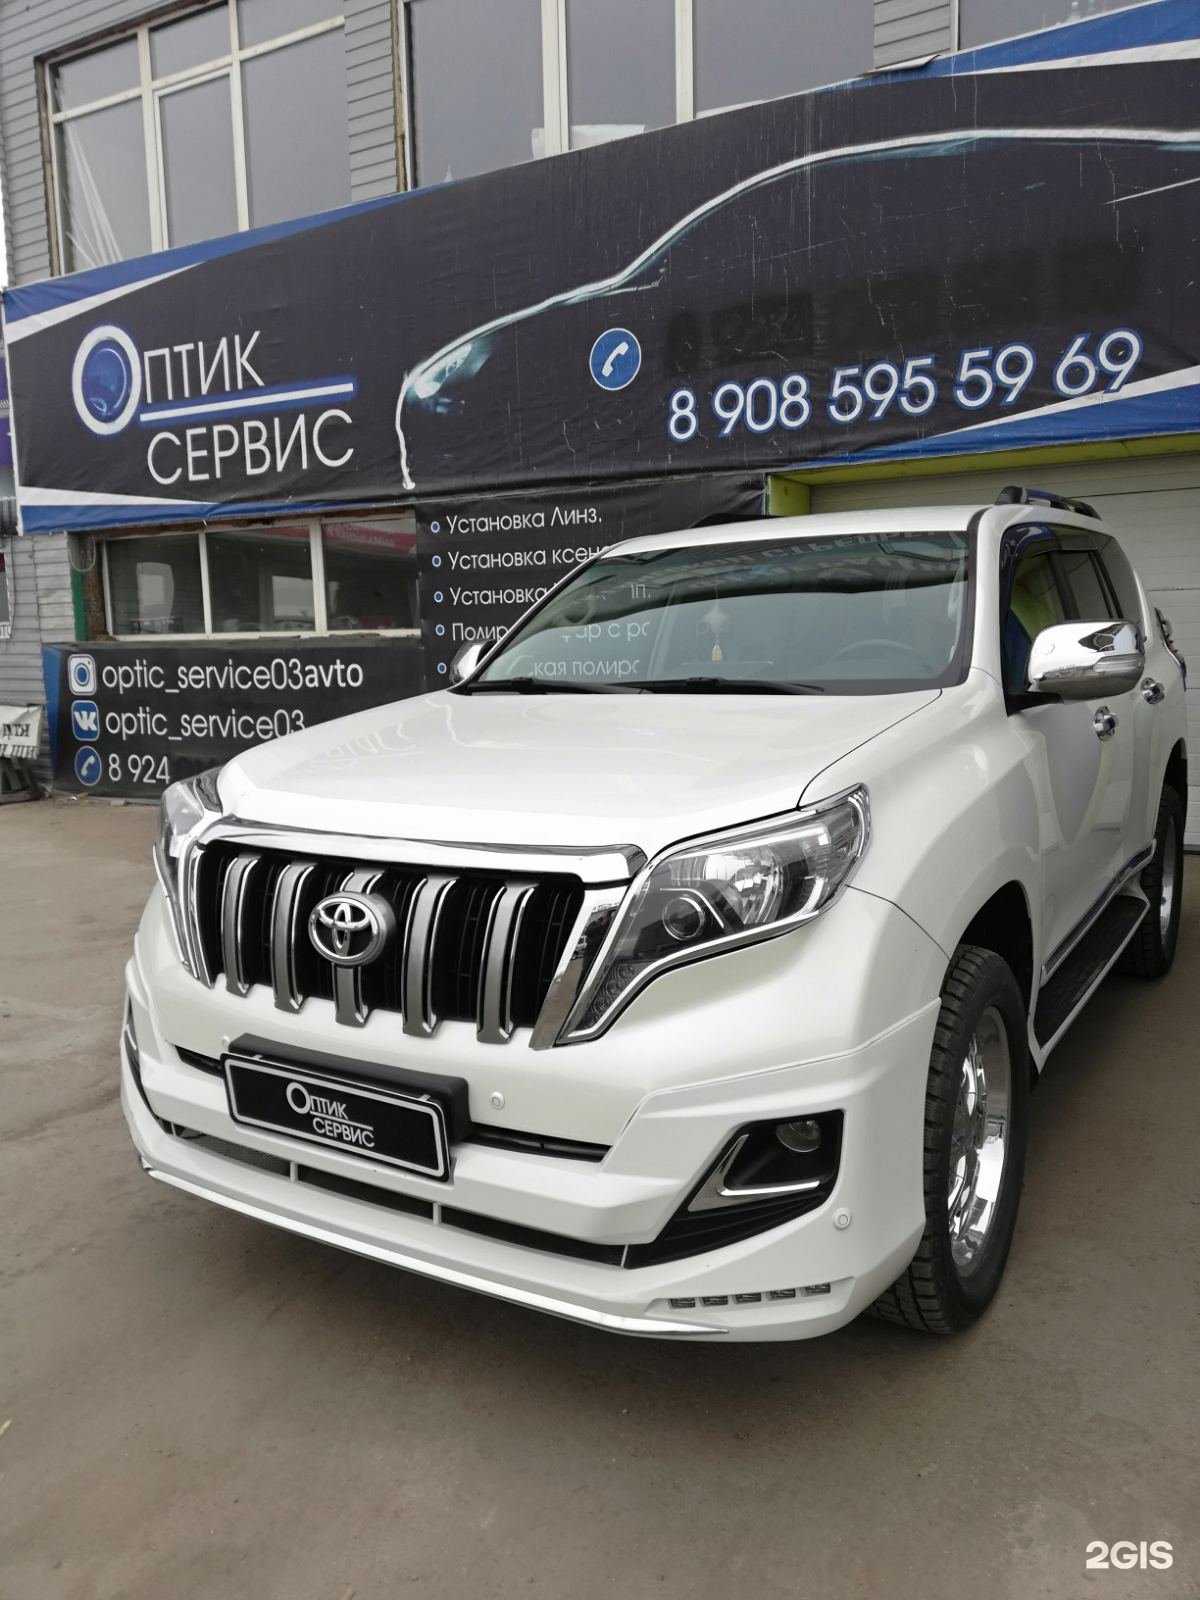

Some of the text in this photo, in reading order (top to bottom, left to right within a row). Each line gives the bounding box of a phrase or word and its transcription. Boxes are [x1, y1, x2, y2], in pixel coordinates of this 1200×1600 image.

[669, 328, 1143, 441] 8 908 595 59 69
[147, 408, 354, 485] СЕРВИС
[446, 506, 602, 535] Установка Линз.
[448, 550, 546, 571] Установка
[607, 622, 621, 638] с
[102, 658, 364, 695] optic_service03avto
[105, 707, 305, 741] optic_service03
[107, 752, 170, 785] 8 924
[312, 1117, 376, 1148] СЕРВИС
